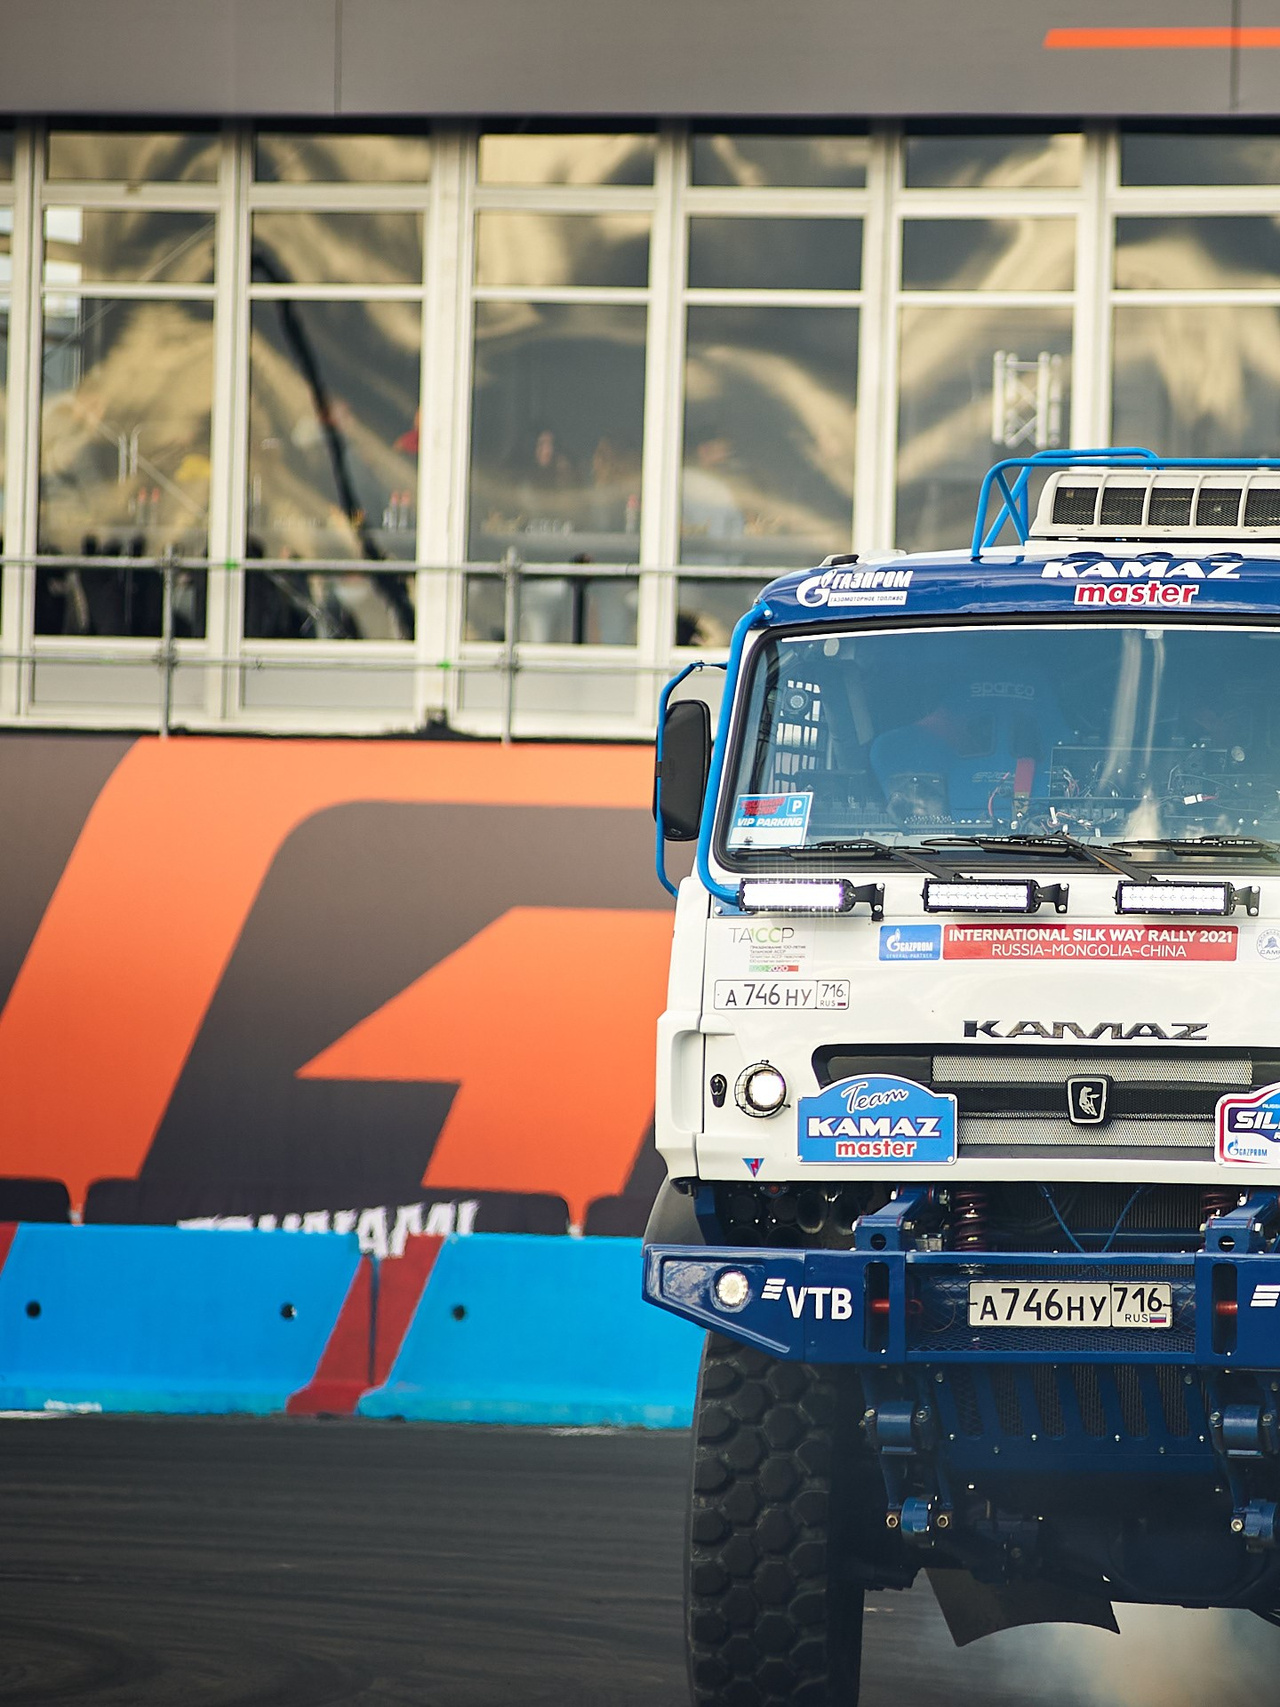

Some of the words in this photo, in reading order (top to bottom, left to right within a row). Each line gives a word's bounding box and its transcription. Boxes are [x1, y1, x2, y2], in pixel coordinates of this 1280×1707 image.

[1041, 562, 1243, 579] KAMAZ
[831, 571, 914, 590] ГАЗПРОМ
[1076, 583, 1196, 604] master
[792, 799, 803, 813] P
[737, 817, 755, 827] VIP
[756, 817, 803, 827] PARKING
[949, 928, 1069, 942] INTERNATIONAL
[1072, 928, 1107, 942] SILK
[1109, 929, 1146, 942] WAY
[1148, 930, 1197, 943] RALLY
[1199, 930, 1233, 944] 2021
[900, 941, 934, 952] GAZPROM
[821, 983, 844, 998] 716
[820, 998, 836, 1007] RUS
[963, 1020, 1209, 1041] KAMAZ
[842, 1082, 908, 1112] Team
[807, 1116, 942, 1138] KAMAZ
[837, 1141, 916, 1157] master
[1238, 1148, 1268, 1157] GAZPROM
[786, 1286, 853, 1320] VTB
[1113, 1287, 1163, 1313] 716
[1124, 1313, 1149, 1323] RUS
